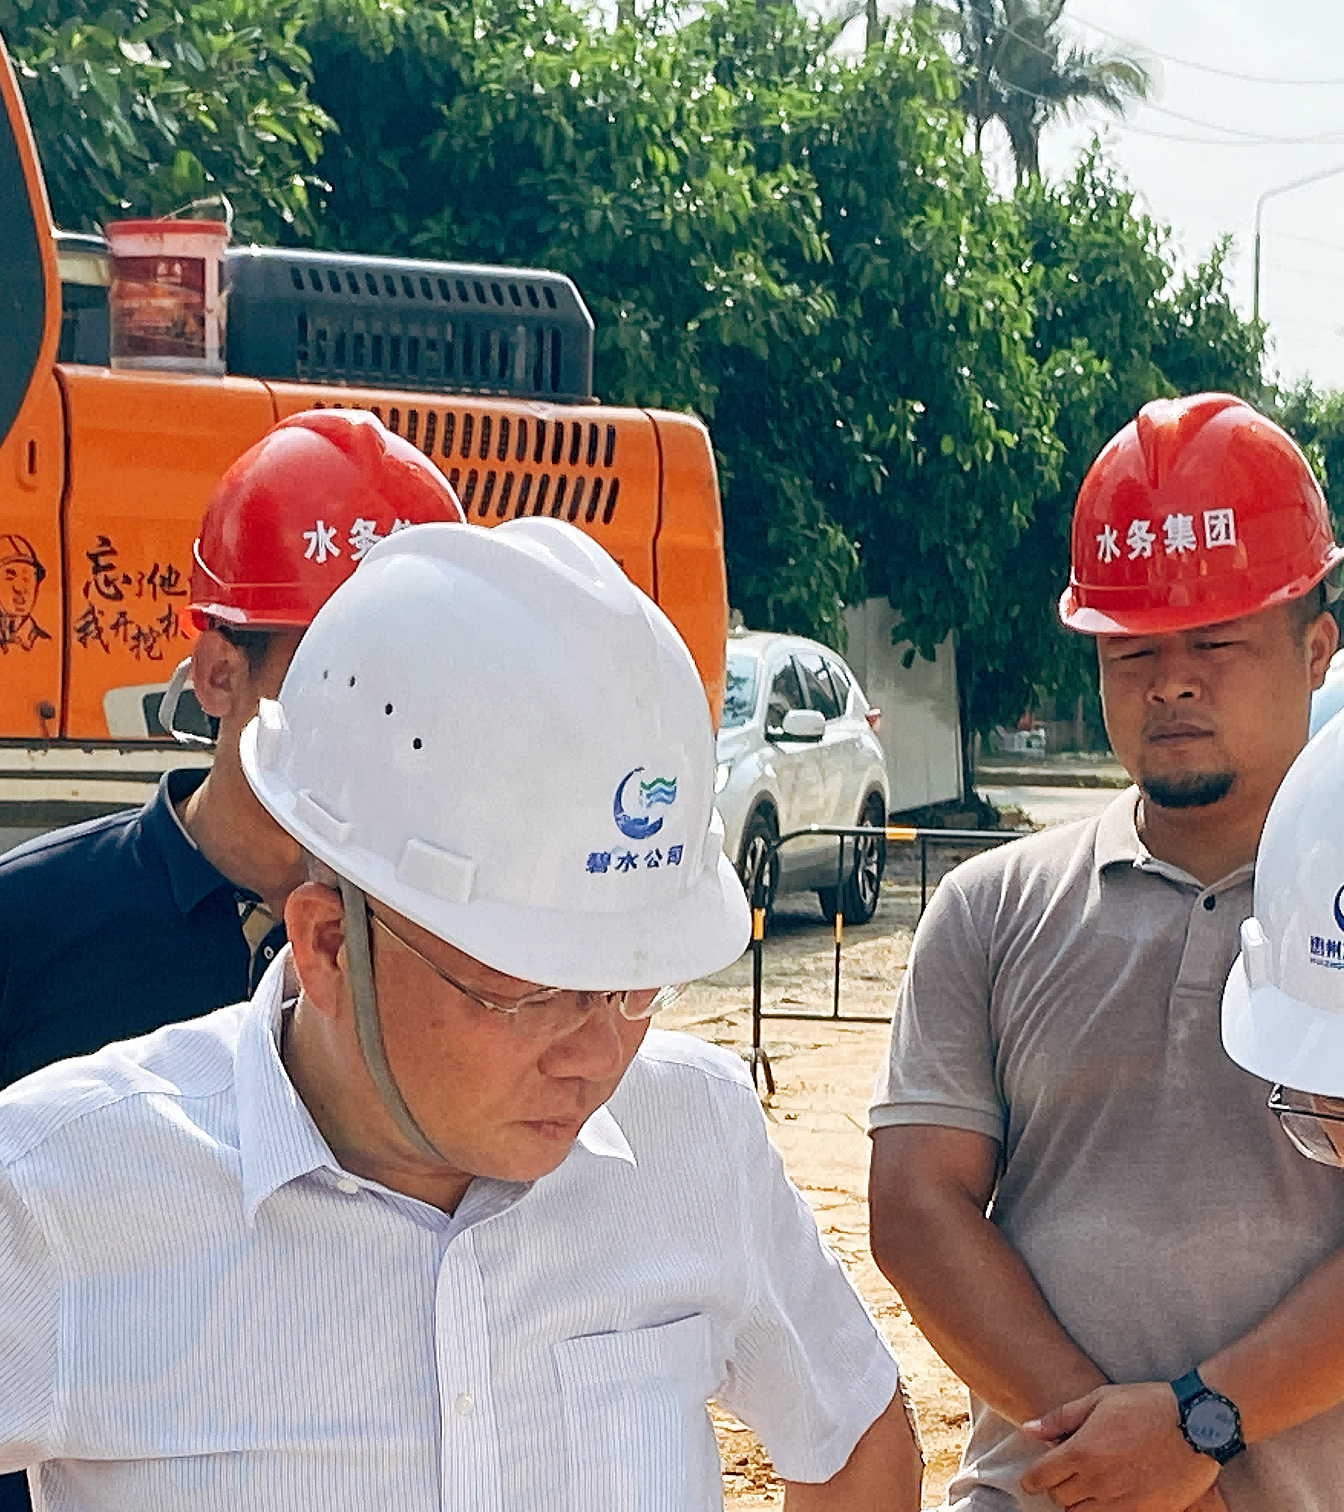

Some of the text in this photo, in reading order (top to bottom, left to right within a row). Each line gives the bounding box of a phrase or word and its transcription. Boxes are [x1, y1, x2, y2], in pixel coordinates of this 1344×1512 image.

[1095, 507, 1237, 564] 水务集团
[585, 843, 685, 874] 碧水公司
